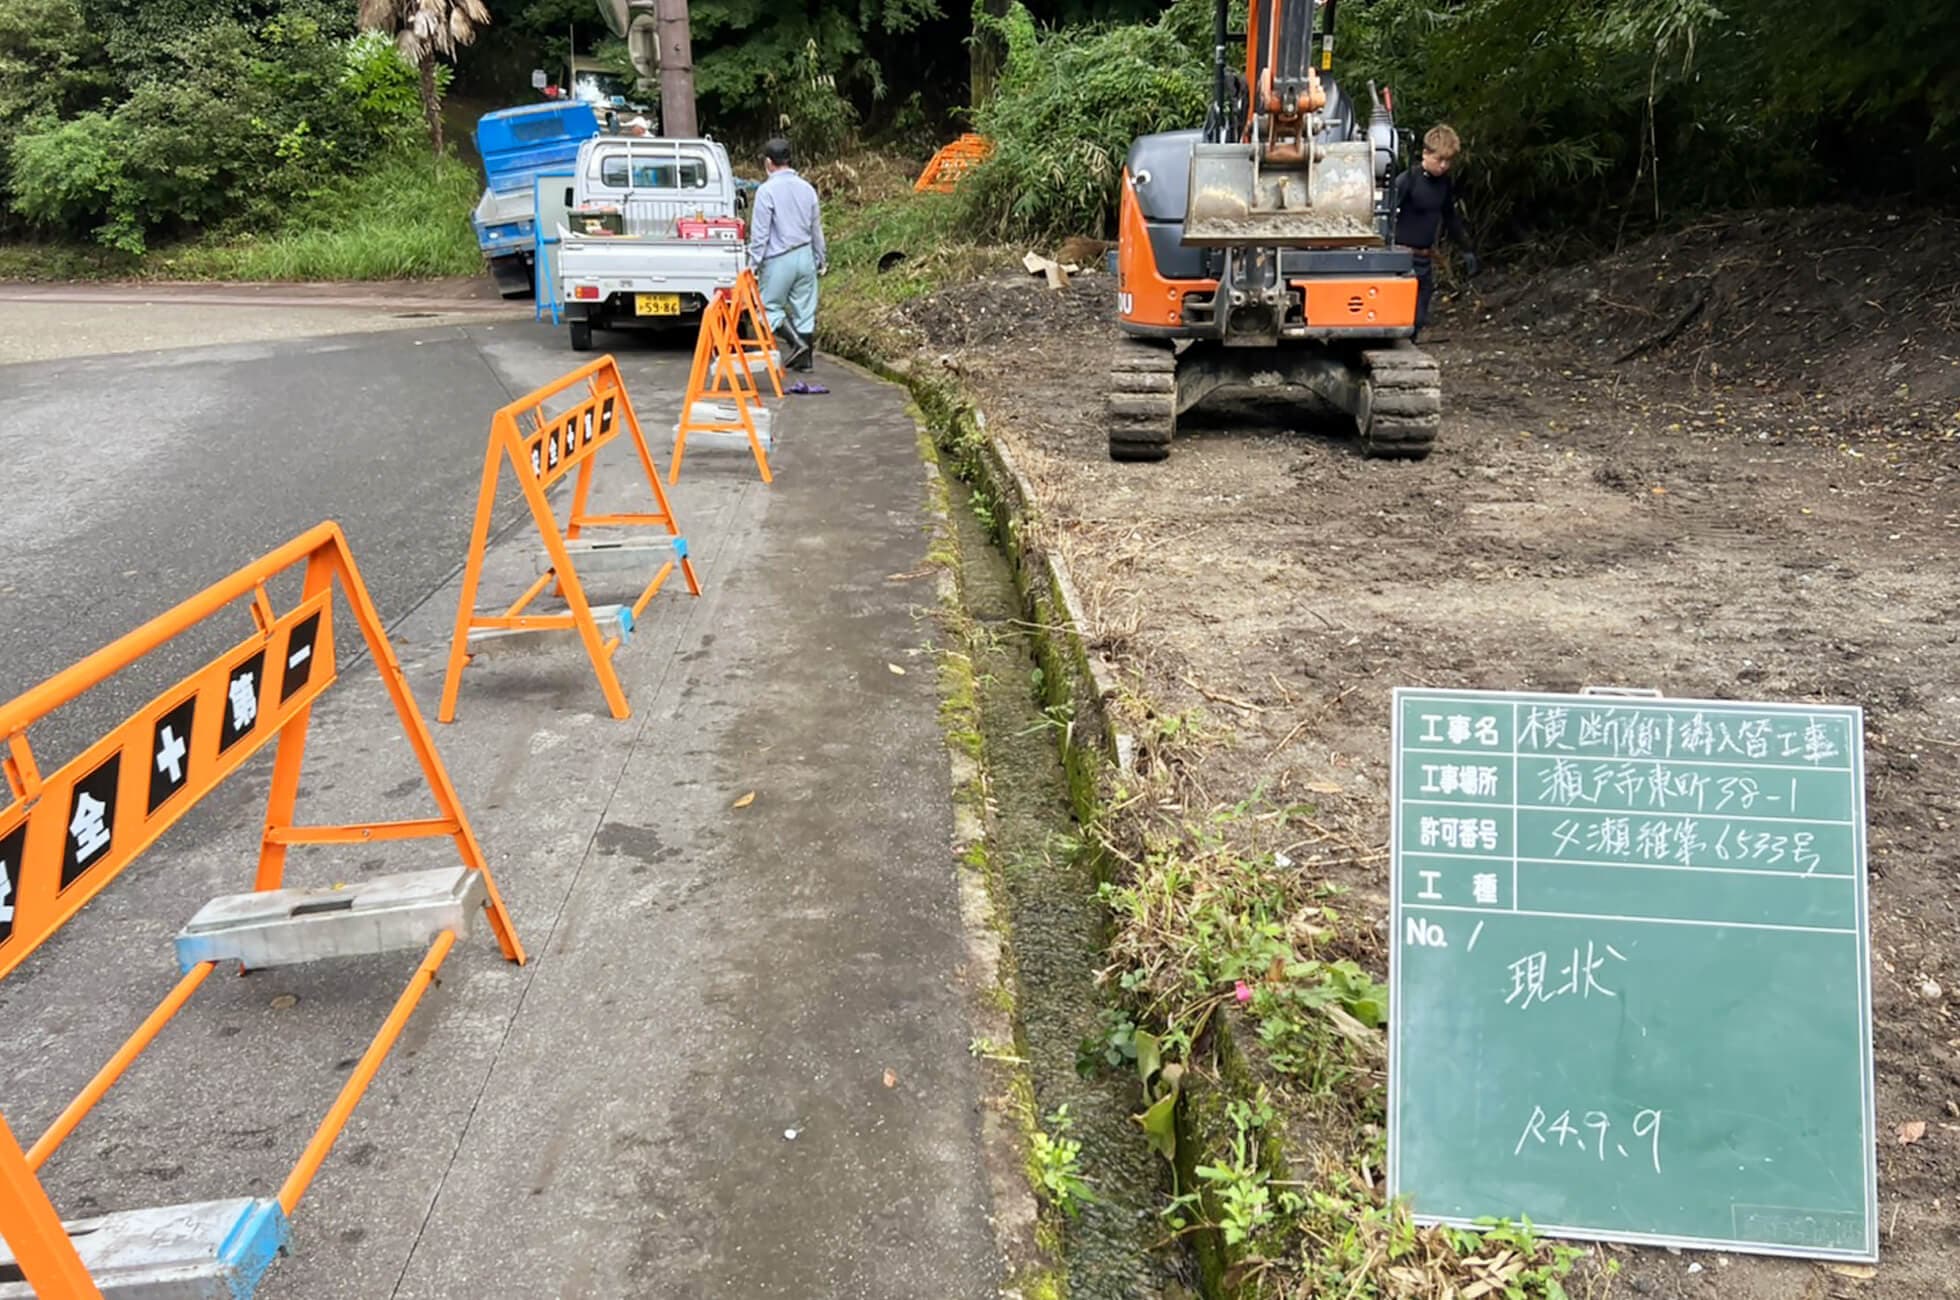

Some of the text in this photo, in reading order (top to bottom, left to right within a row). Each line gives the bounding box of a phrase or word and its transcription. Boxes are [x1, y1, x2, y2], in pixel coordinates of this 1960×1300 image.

[1419, 713, 1499, 747] 工事名
[1420, 763, 1499, 798] 工事場所
[1420, 816, 1499, 850] 許可番号
[1406, 917, 1448, 948] No.
[1504, 940, 1627, 1009] 現状
